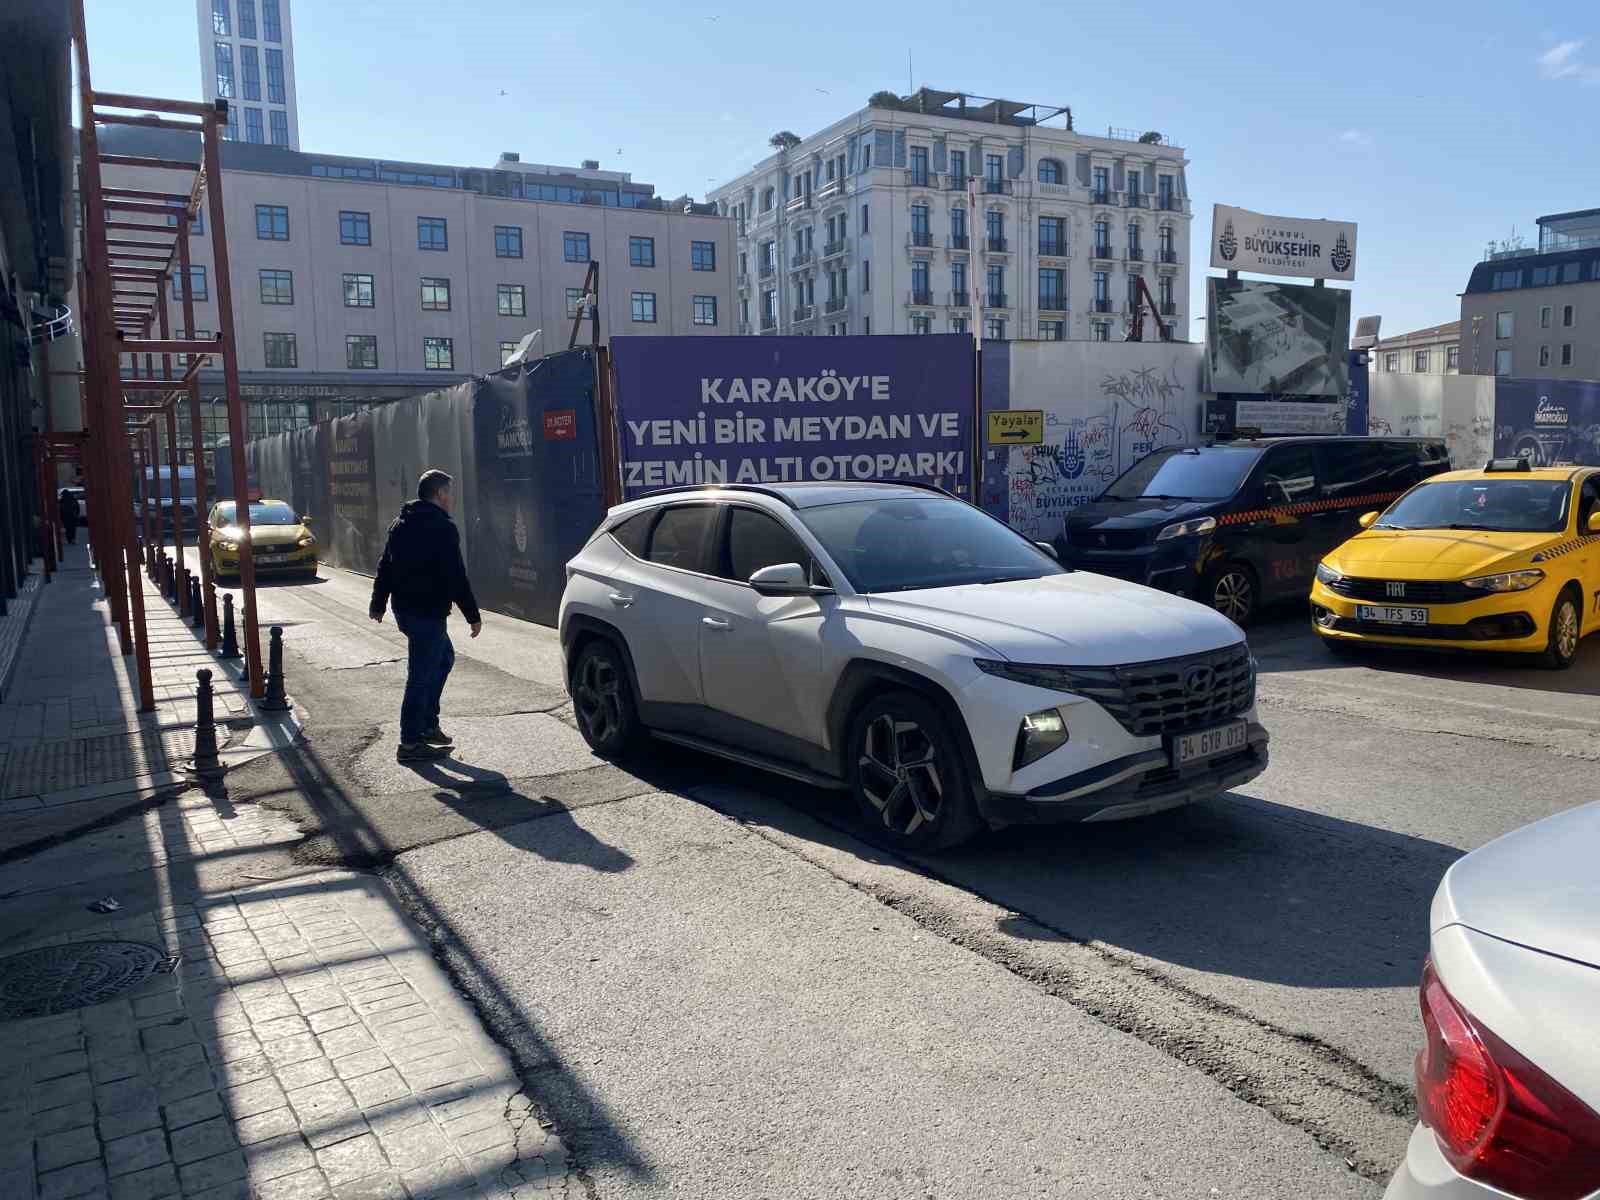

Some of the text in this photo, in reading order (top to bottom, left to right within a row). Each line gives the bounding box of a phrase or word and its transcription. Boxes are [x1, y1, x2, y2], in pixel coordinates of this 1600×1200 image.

[1244, 234, 1321, 259] BÜYÜKŞEHİR
[701, 369, 890, 403] KARAKÖY'E
[627, 410, 959, 446] YENİ BİR MEYDAN VE
[993, 415, 1040, 430] Yayalar
[625, 451, 964, 487] ZEMİN ALTI OTOPARKI
[1385, 581, 1407, 598] FIAT
[1364, 606, 1424, 622] 34 TFS 59
[1182, 735, 1194, 760] 34
